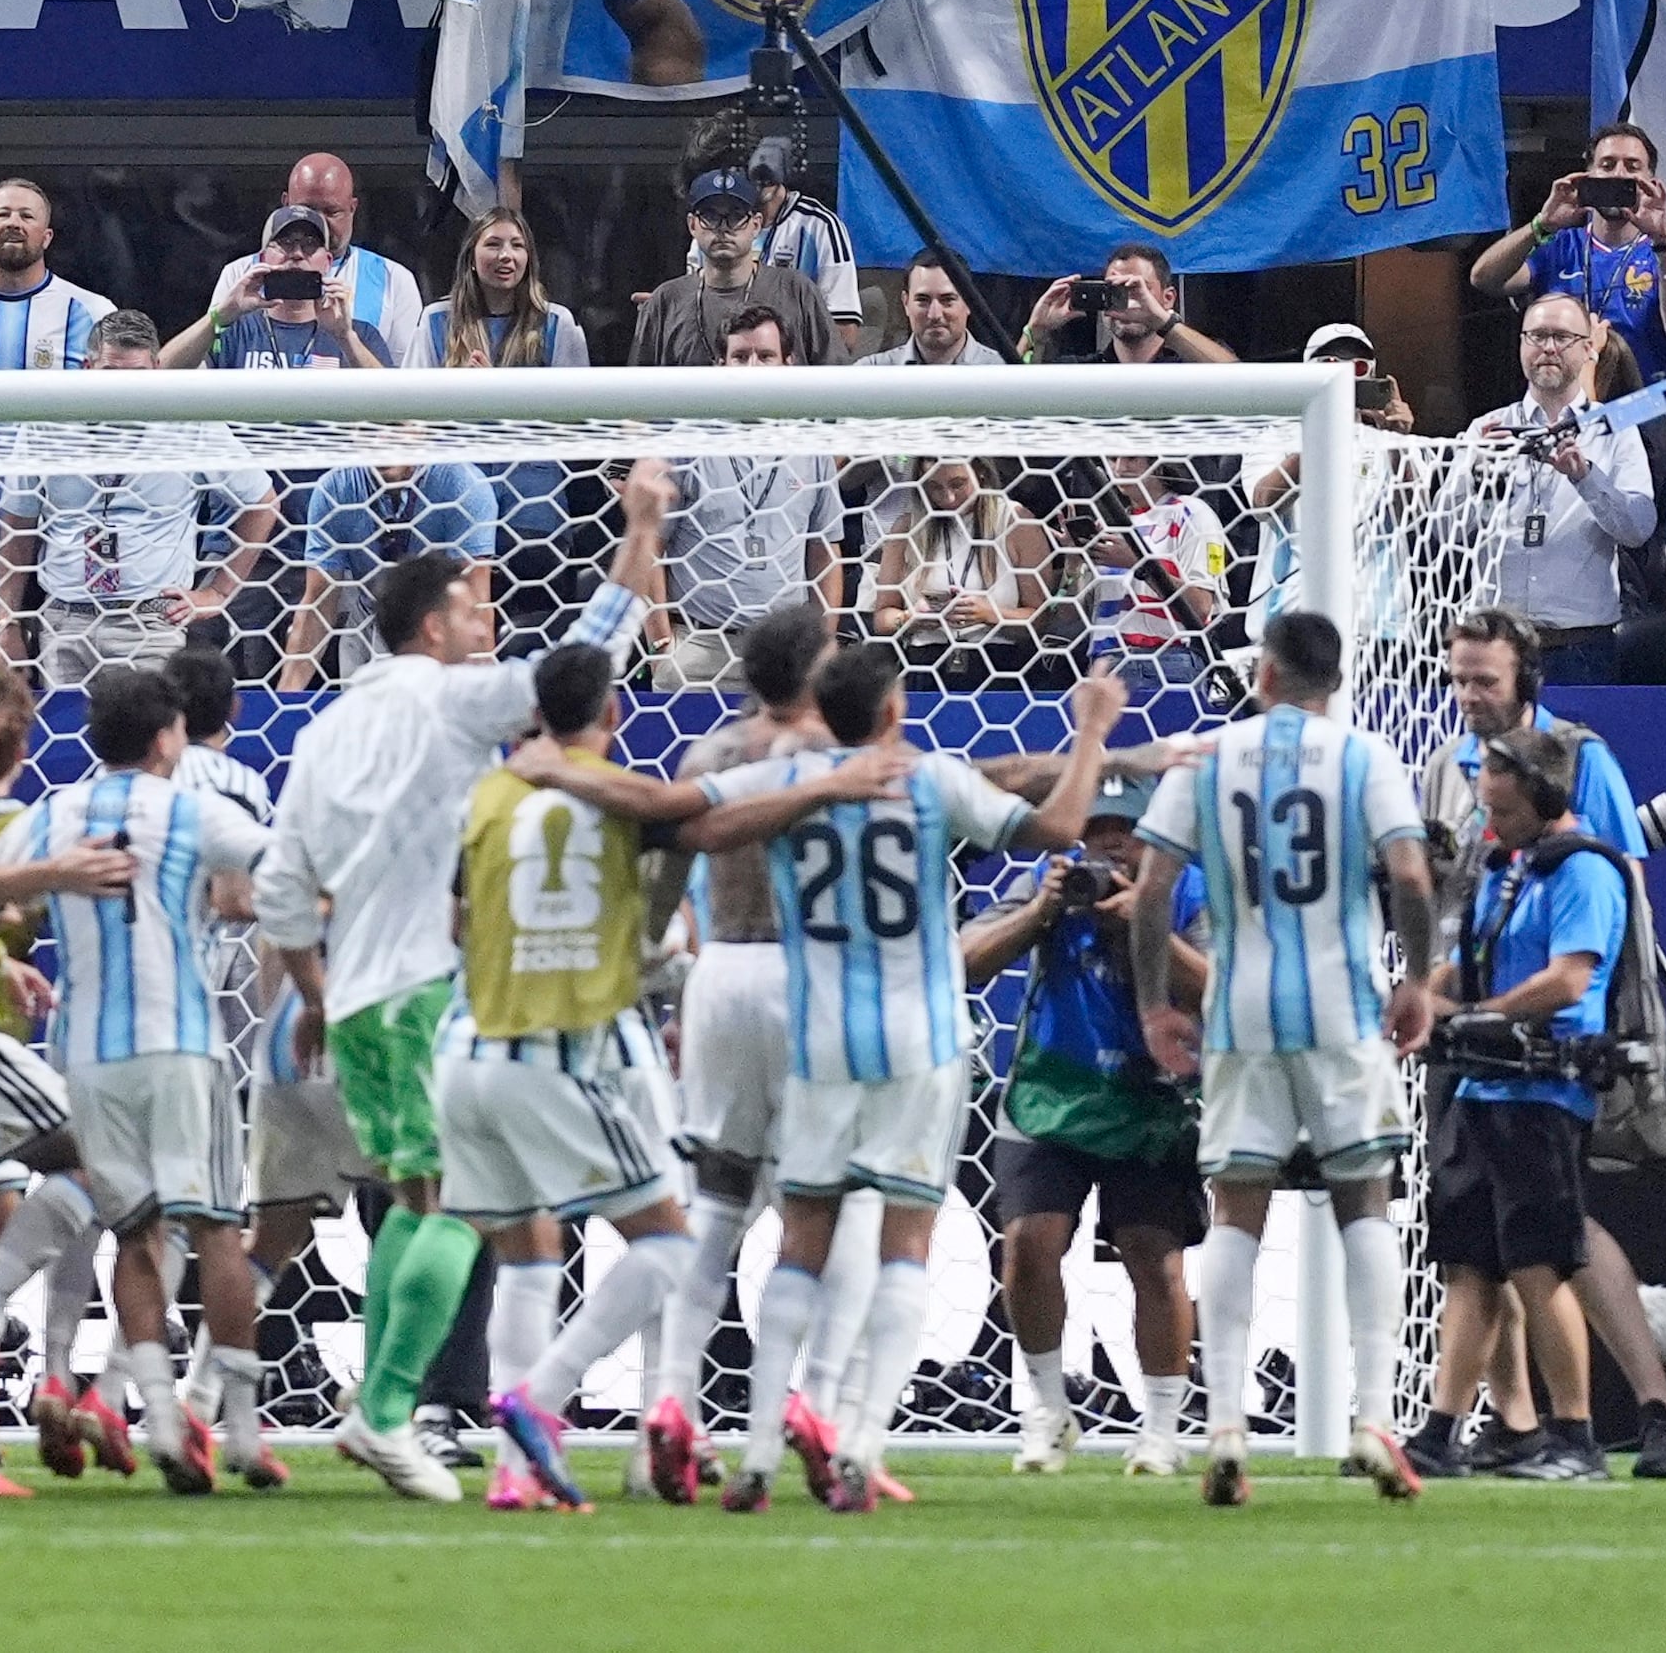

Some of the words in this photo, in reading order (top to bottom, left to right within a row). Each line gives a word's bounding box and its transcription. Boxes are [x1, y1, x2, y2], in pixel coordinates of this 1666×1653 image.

[1341, 103, 1437, 216] 32
[793, 818, 919, 943] 26
[1232, 787, 1327, 908] 13
